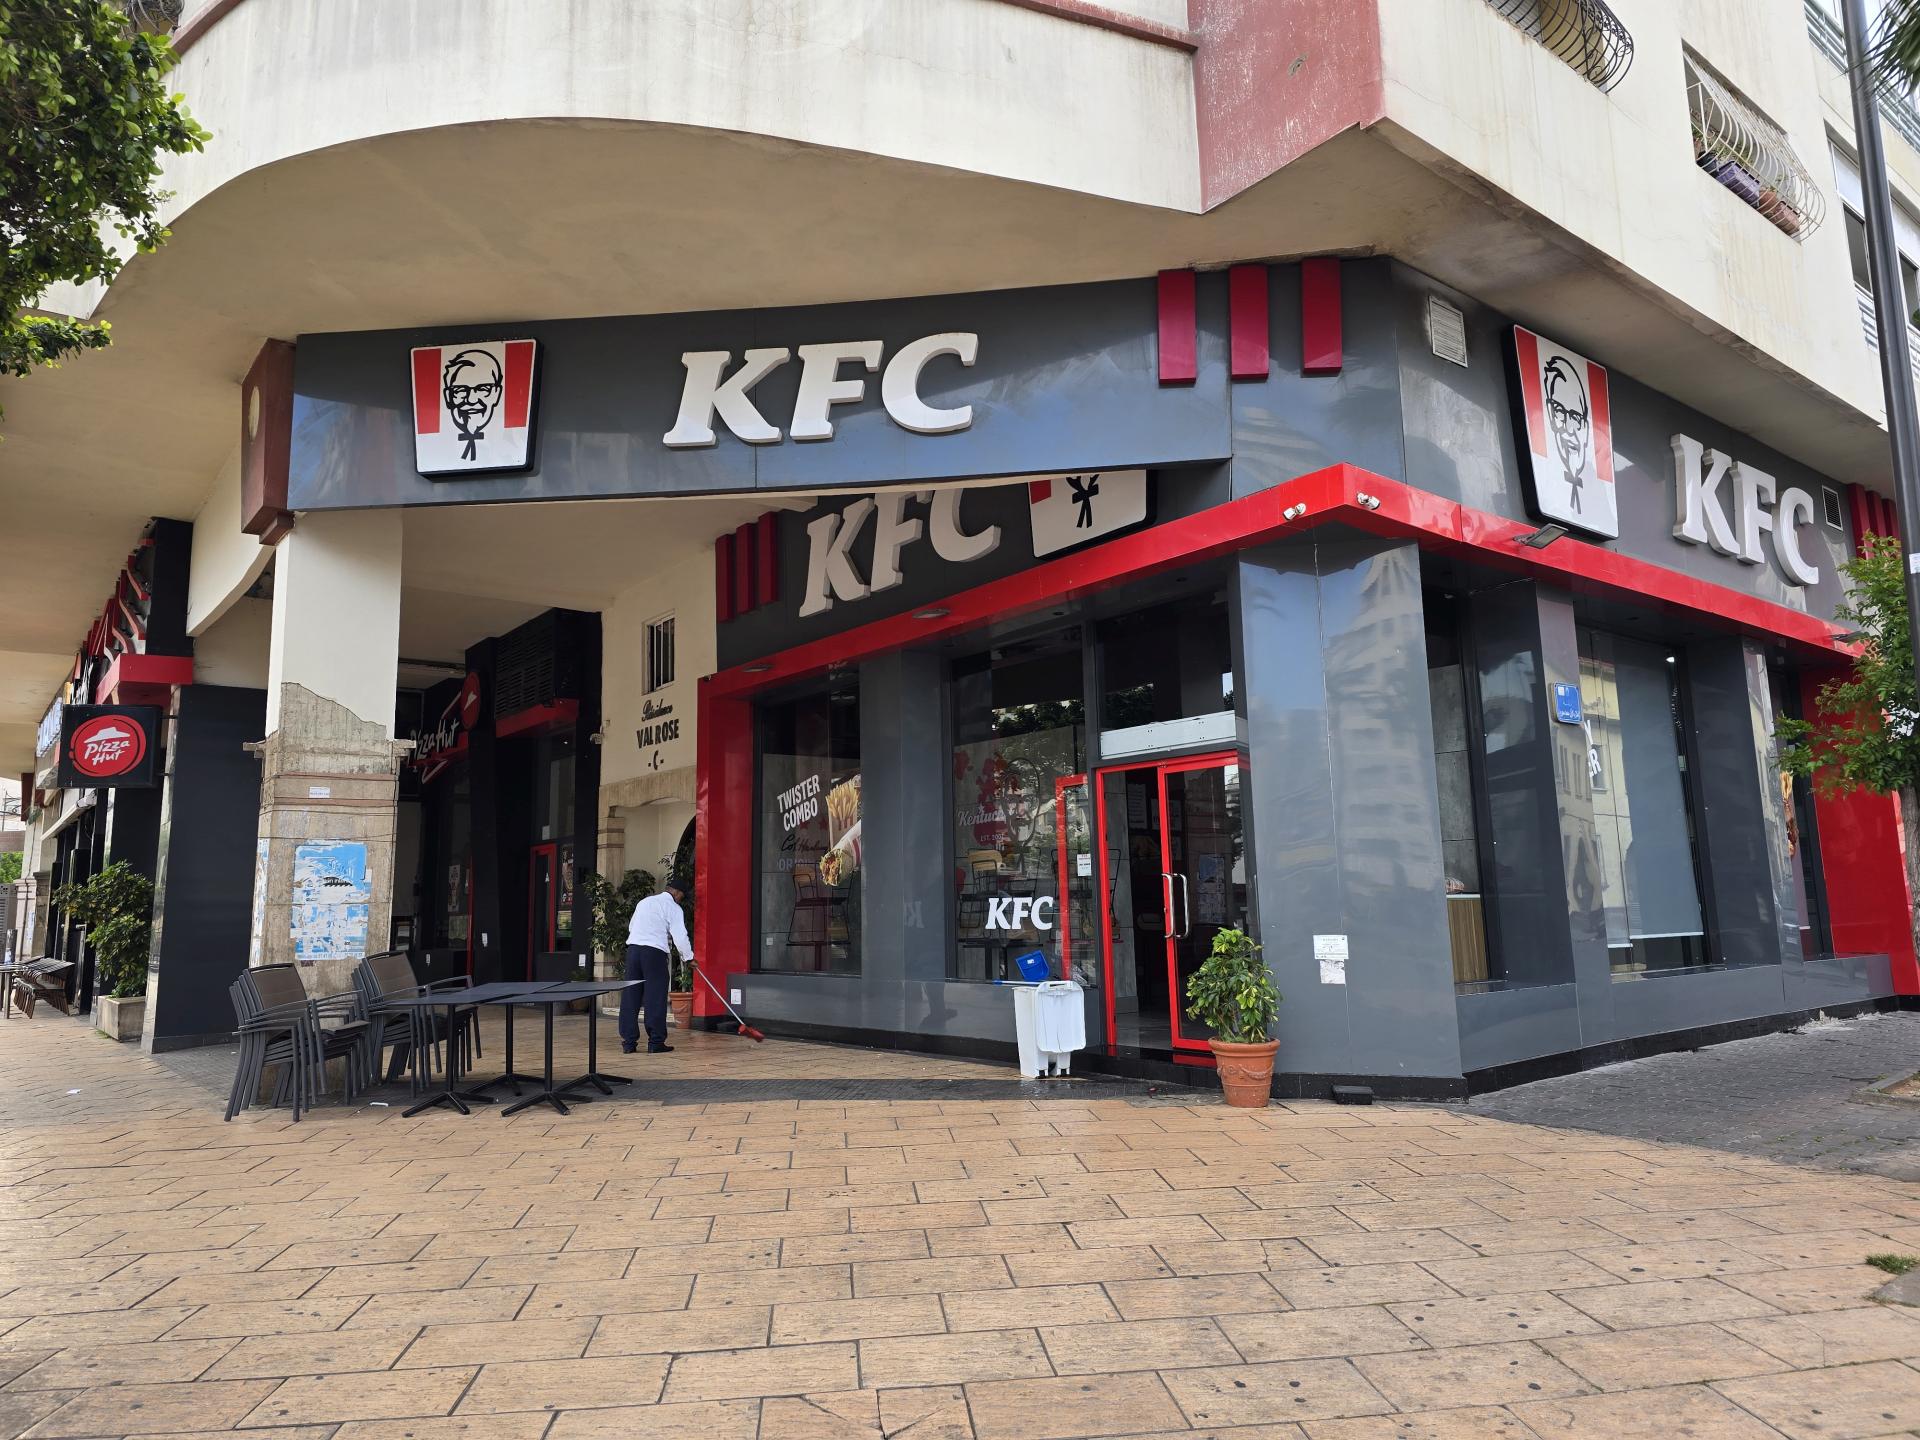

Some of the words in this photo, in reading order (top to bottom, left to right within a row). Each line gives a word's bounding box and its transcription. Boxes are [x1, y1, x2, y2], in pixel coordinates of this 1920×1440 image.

[663, 332, 979, 448] KFC
[1670, 433, 1819, 586] KFC
[799, 488, 1001, 617] KFC
[84, 740, 131, 760] Pizza
[435, 717, 460, 752] Hut
[636, 725, 654, 749] VAL
[655, 718, 680, 745] ROSE
[92, 750, 125, 766] Hut
[777, 774, 821, 813] TWISTER
[783, 797, 818, 831] COMBO
[985, 896, 1054, 930] KFC
